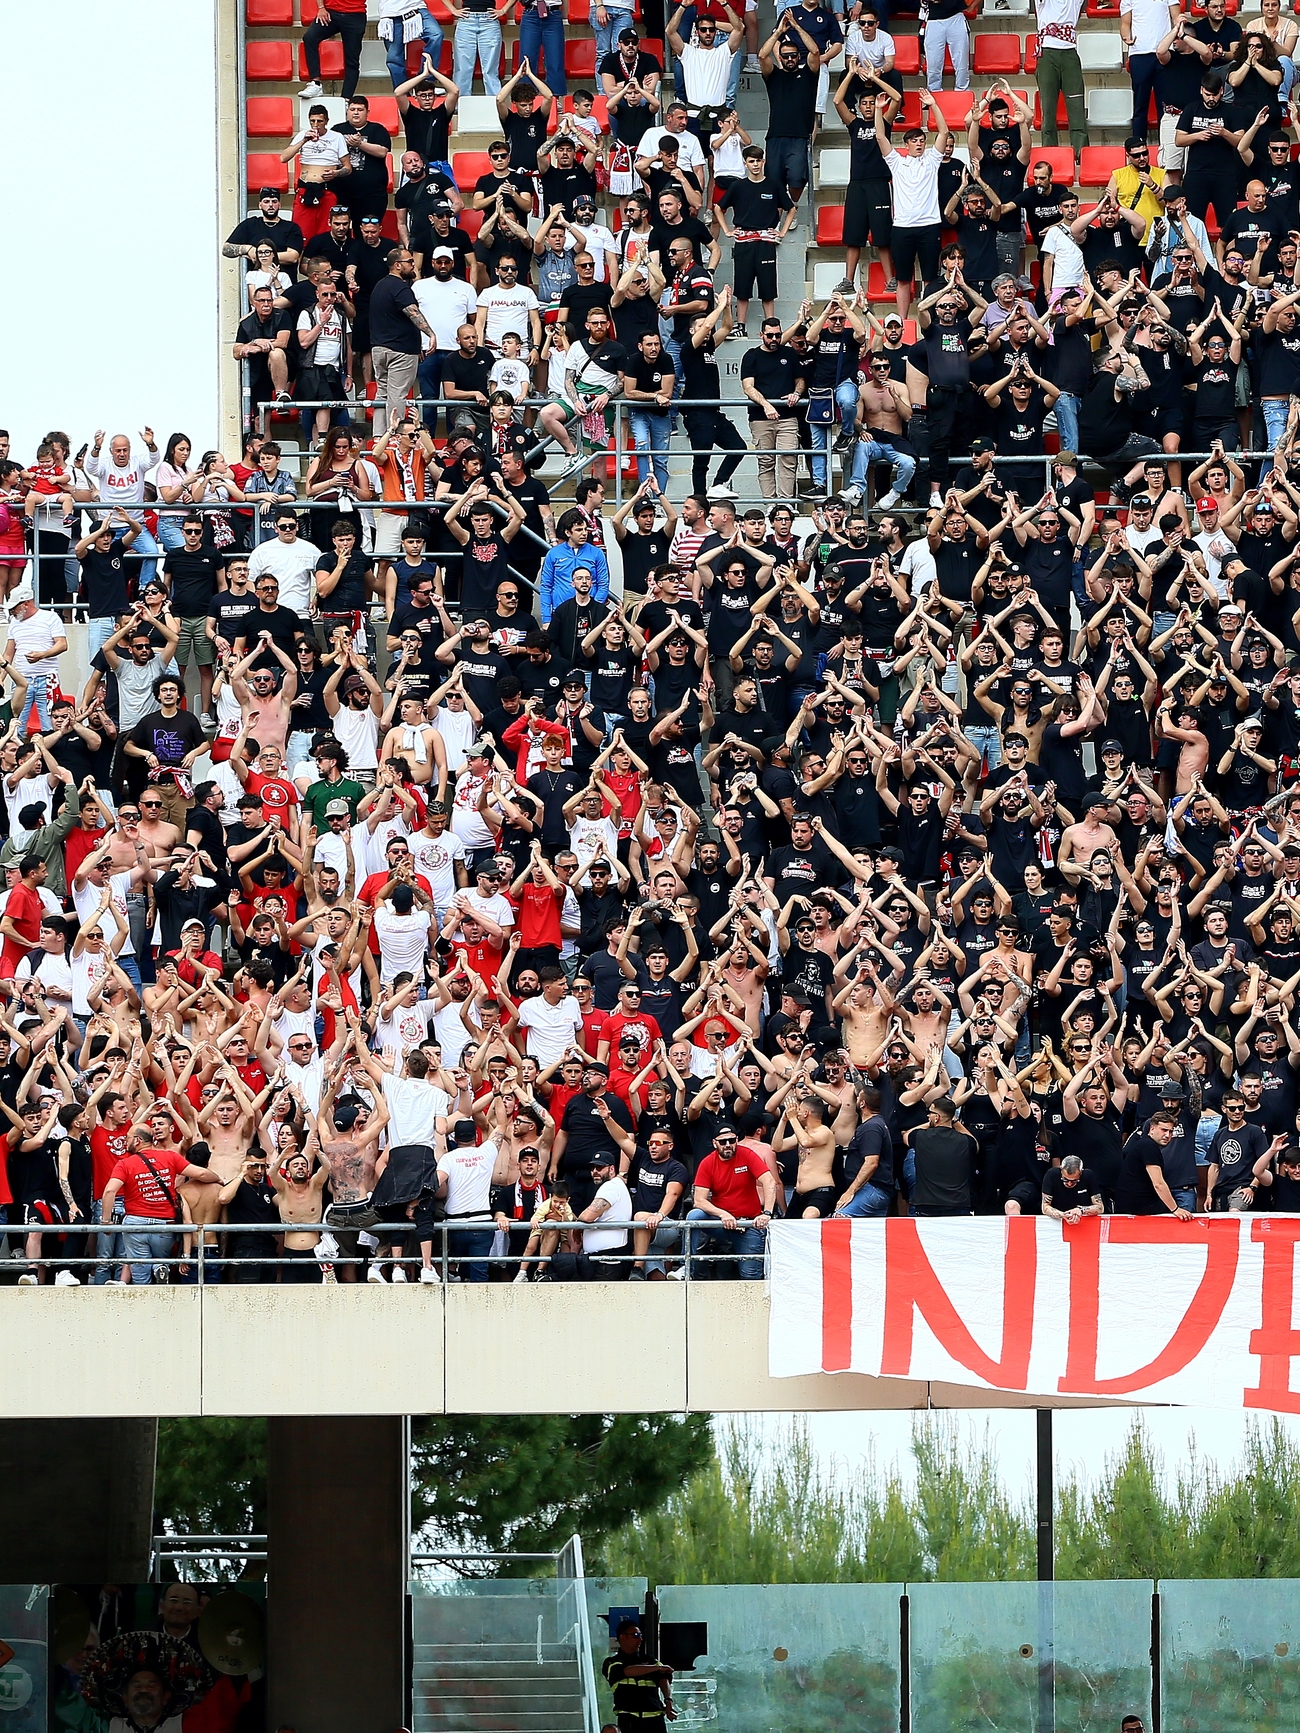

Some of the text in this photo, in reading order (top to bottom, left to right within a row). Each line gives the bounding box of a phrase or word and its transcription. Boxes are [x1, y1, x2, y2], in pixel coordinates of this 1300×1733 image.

[739, 77, 751, 90] 21
[726, 363, 738, 375] 16
[107, 470, 139, 488] BARI
